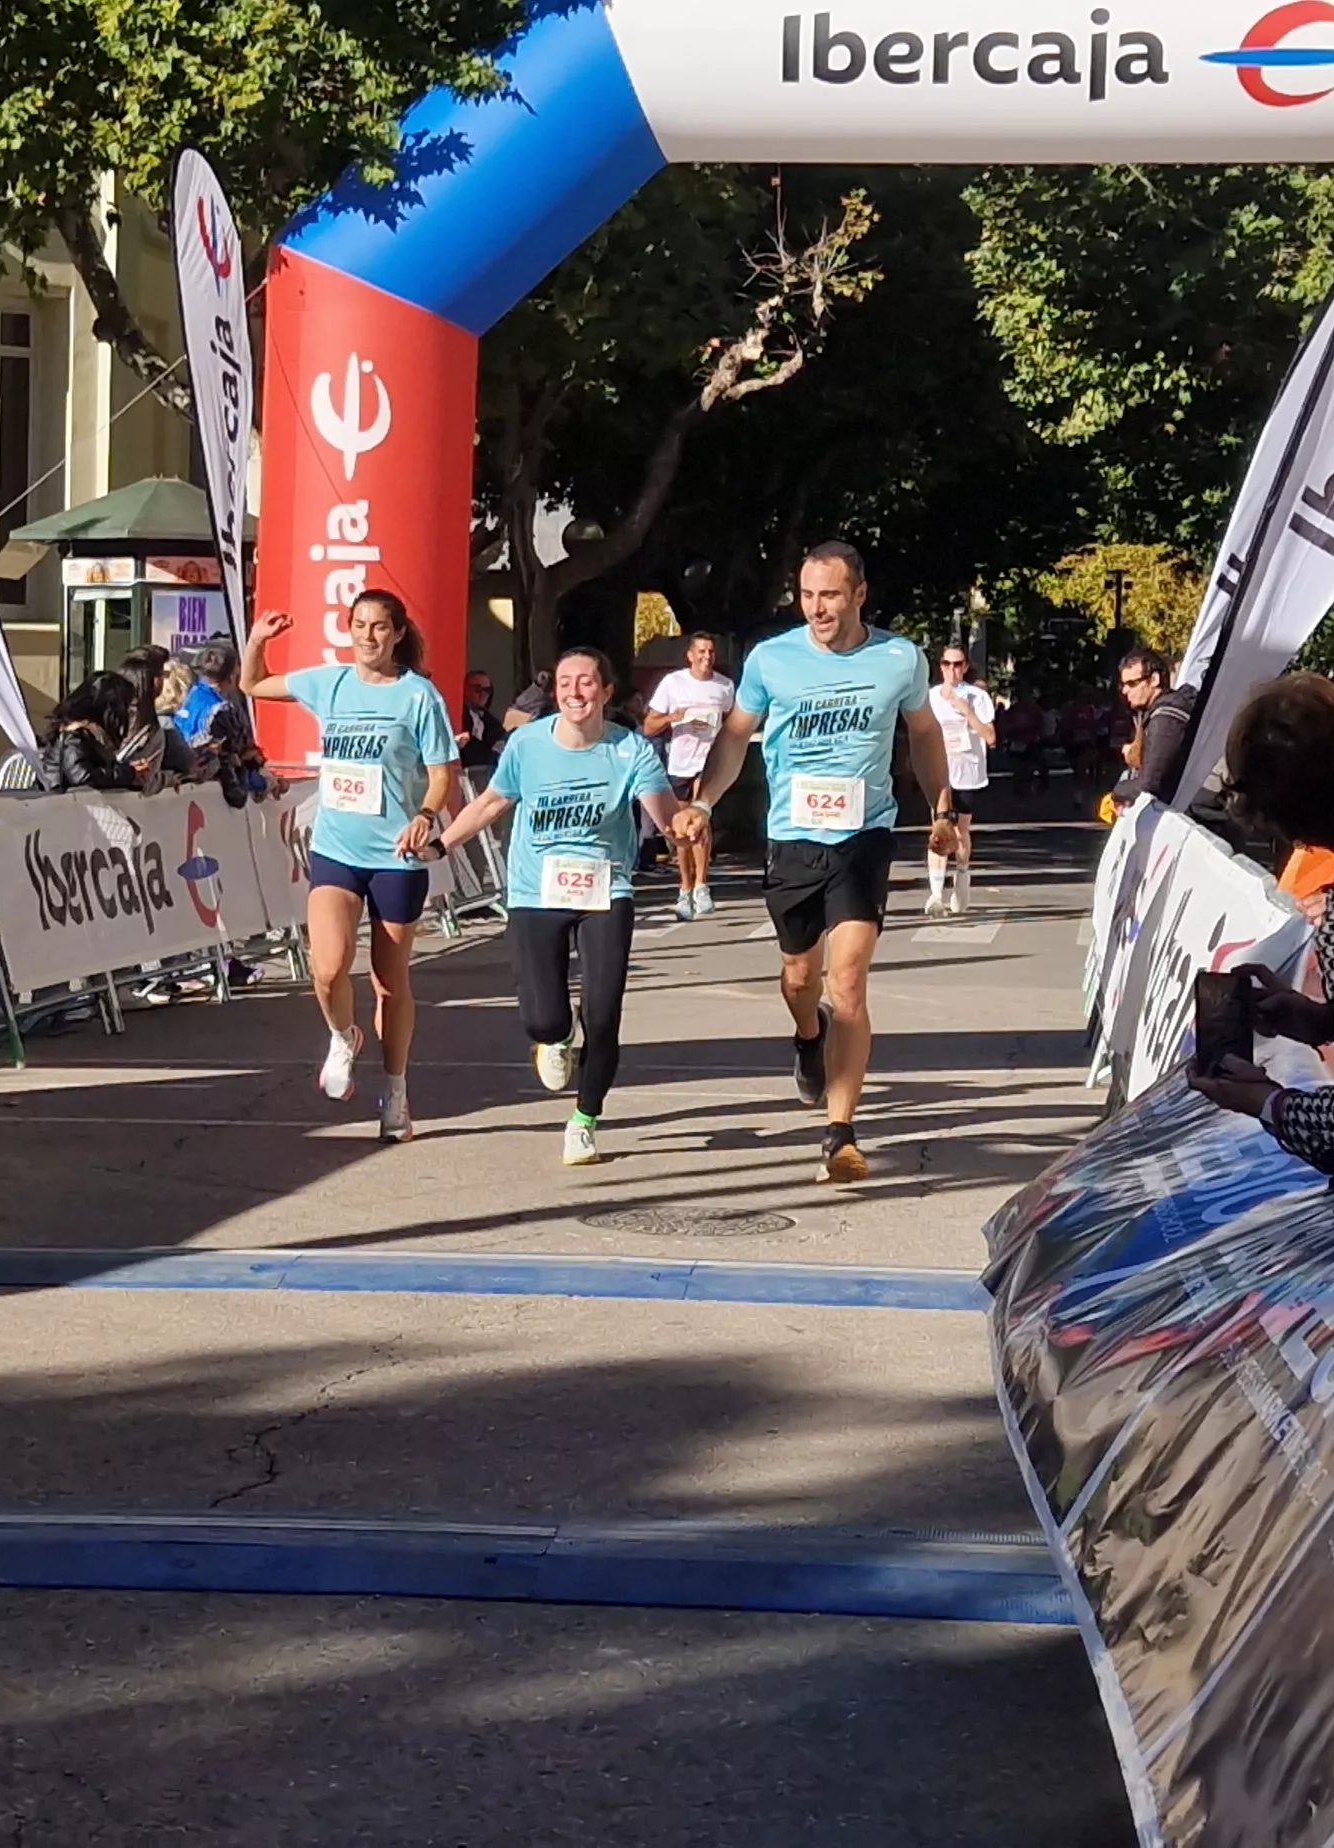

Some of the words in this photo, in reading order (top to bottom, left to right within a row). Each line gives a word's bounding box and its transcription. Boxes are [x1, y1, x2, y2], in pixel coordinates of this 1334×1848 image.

[781, 8, 1170, 102] Ibercaja
[321, 734, 389, 761] MPRESAS
[332, 777, 365, 796] 626
[806, 793, 848, 810] 624
[530, 801, 607, 834] MPRESAS
[24, 815, 174, 936] Ibercaja
[557, 871, 595, 889] 625
